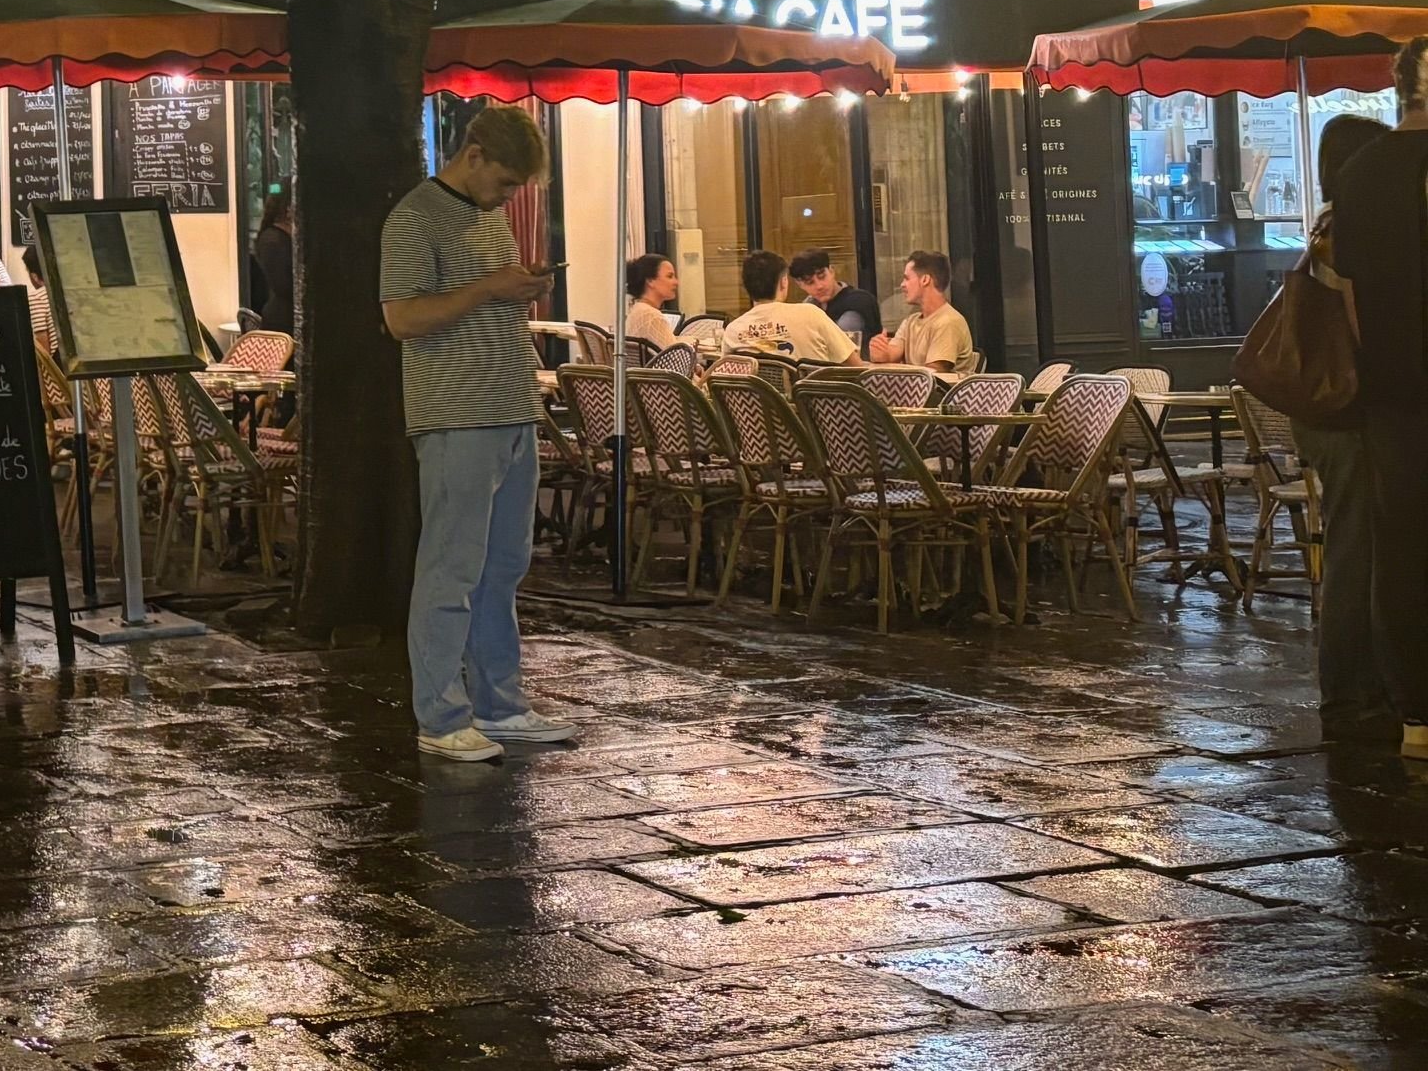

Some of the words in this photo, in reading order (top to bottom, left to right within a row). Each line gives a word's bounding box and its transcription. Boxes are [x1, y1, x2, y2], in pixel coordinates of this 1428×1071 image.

[1041, 119, 1062, 128] CES
[135, 135, 156, 143] NOS
[160, 133, 184, 142] TAPAS
[1022, 142, 1066, 151] SBETS
[1020, 164, 1069, 176] GITÉS
[1051, 189, 1098, 199] ORIGINES
[1046, 213, 1086, 223] TISANAL
